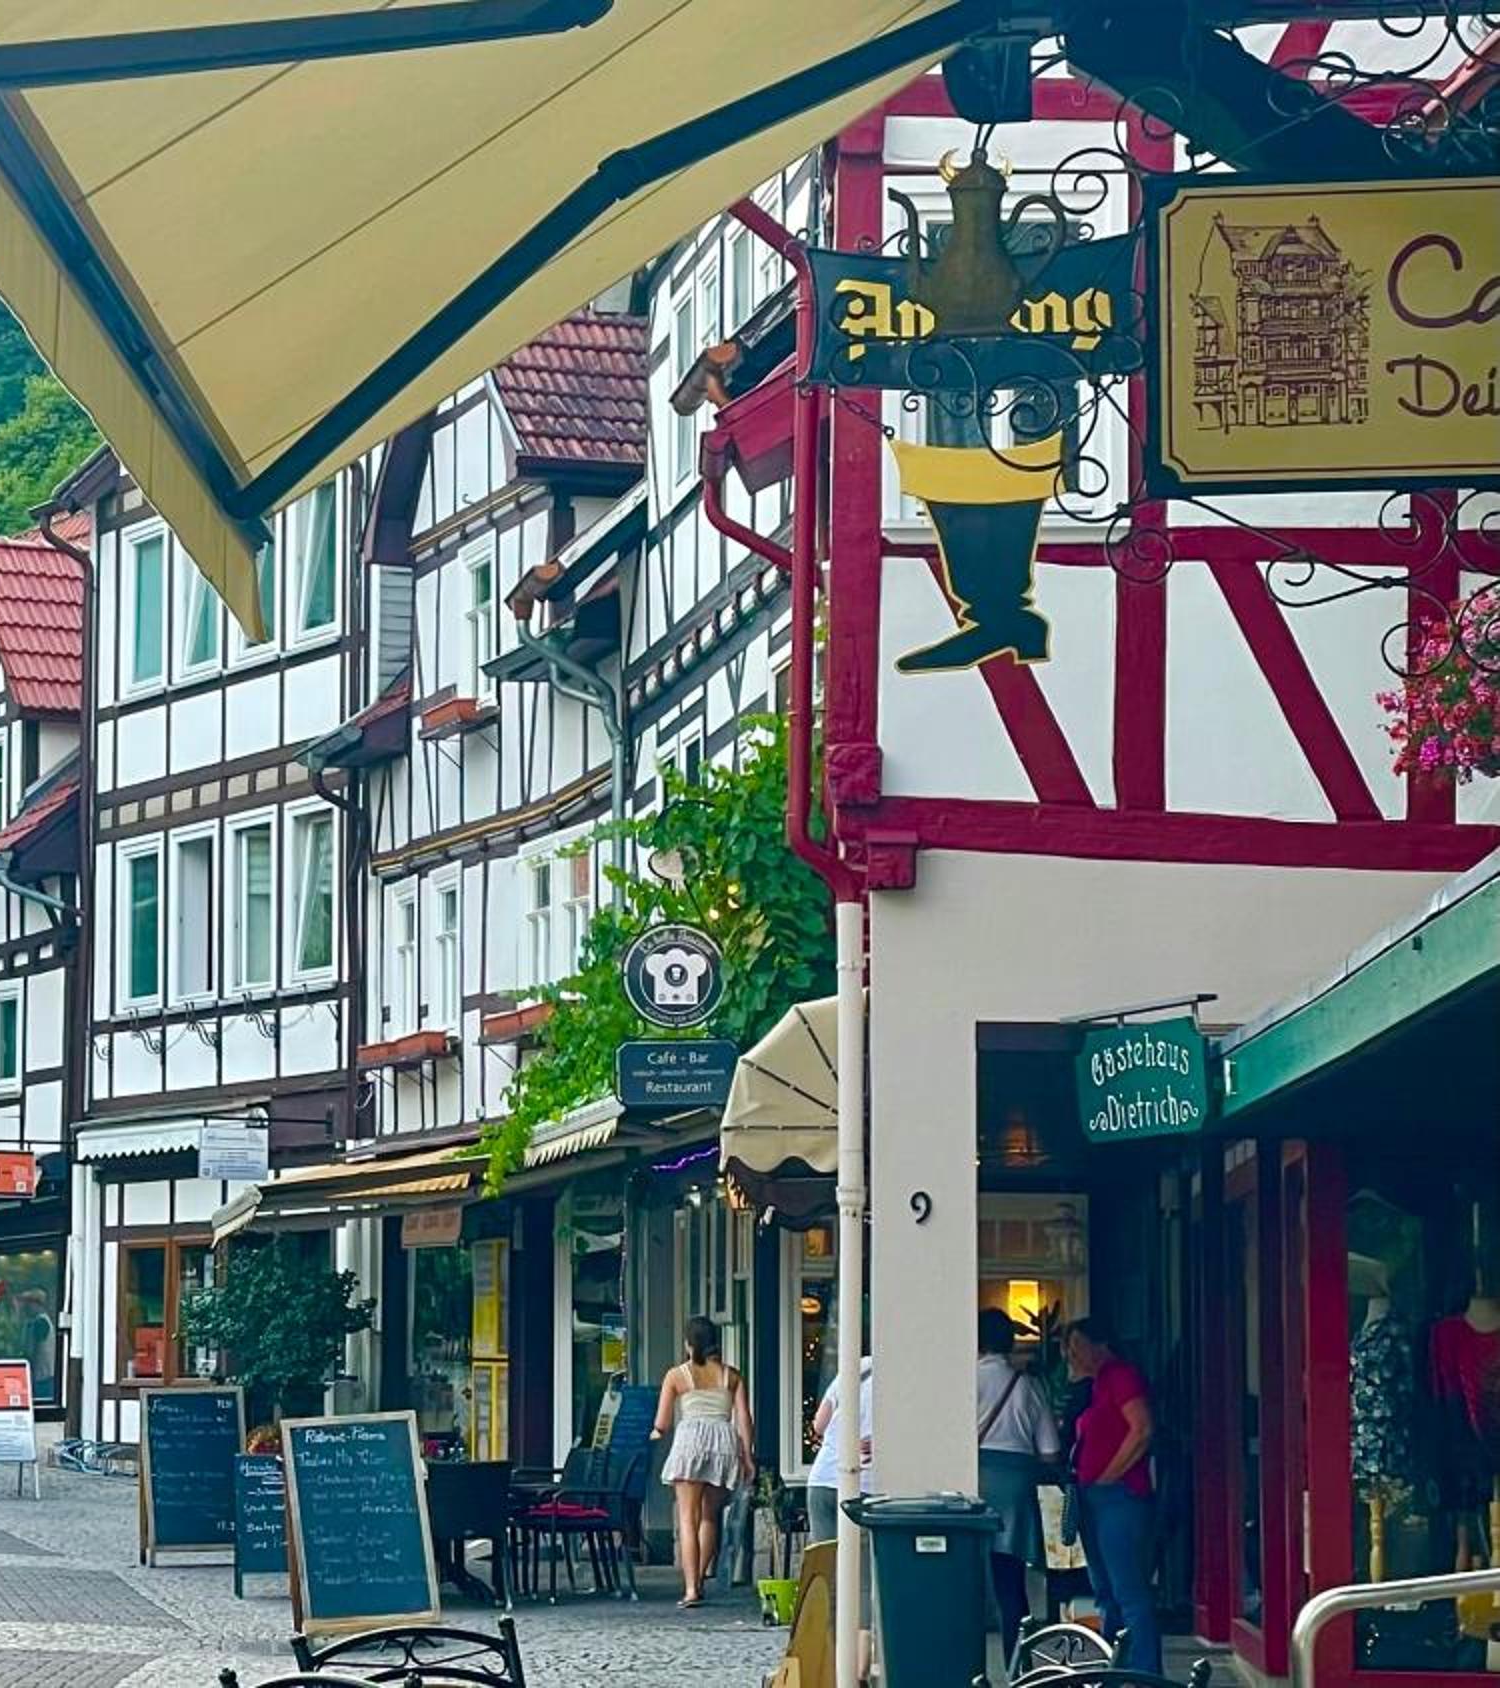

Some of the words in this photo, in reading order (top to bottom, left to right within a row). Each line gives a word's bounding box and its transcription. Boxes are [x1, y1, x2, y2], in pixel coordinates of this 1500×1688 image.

[647, 1051, 678, 1065] Café
[689, 1051, 709, 1064] Bar
[1091, 1032, 1189, 1086] Gästehaus
[645, 1081, 713, 1093] Restaurant
[1107, 1085, 1179, 1131] Dietrich
[910, 1191, 932, 1224] 9
